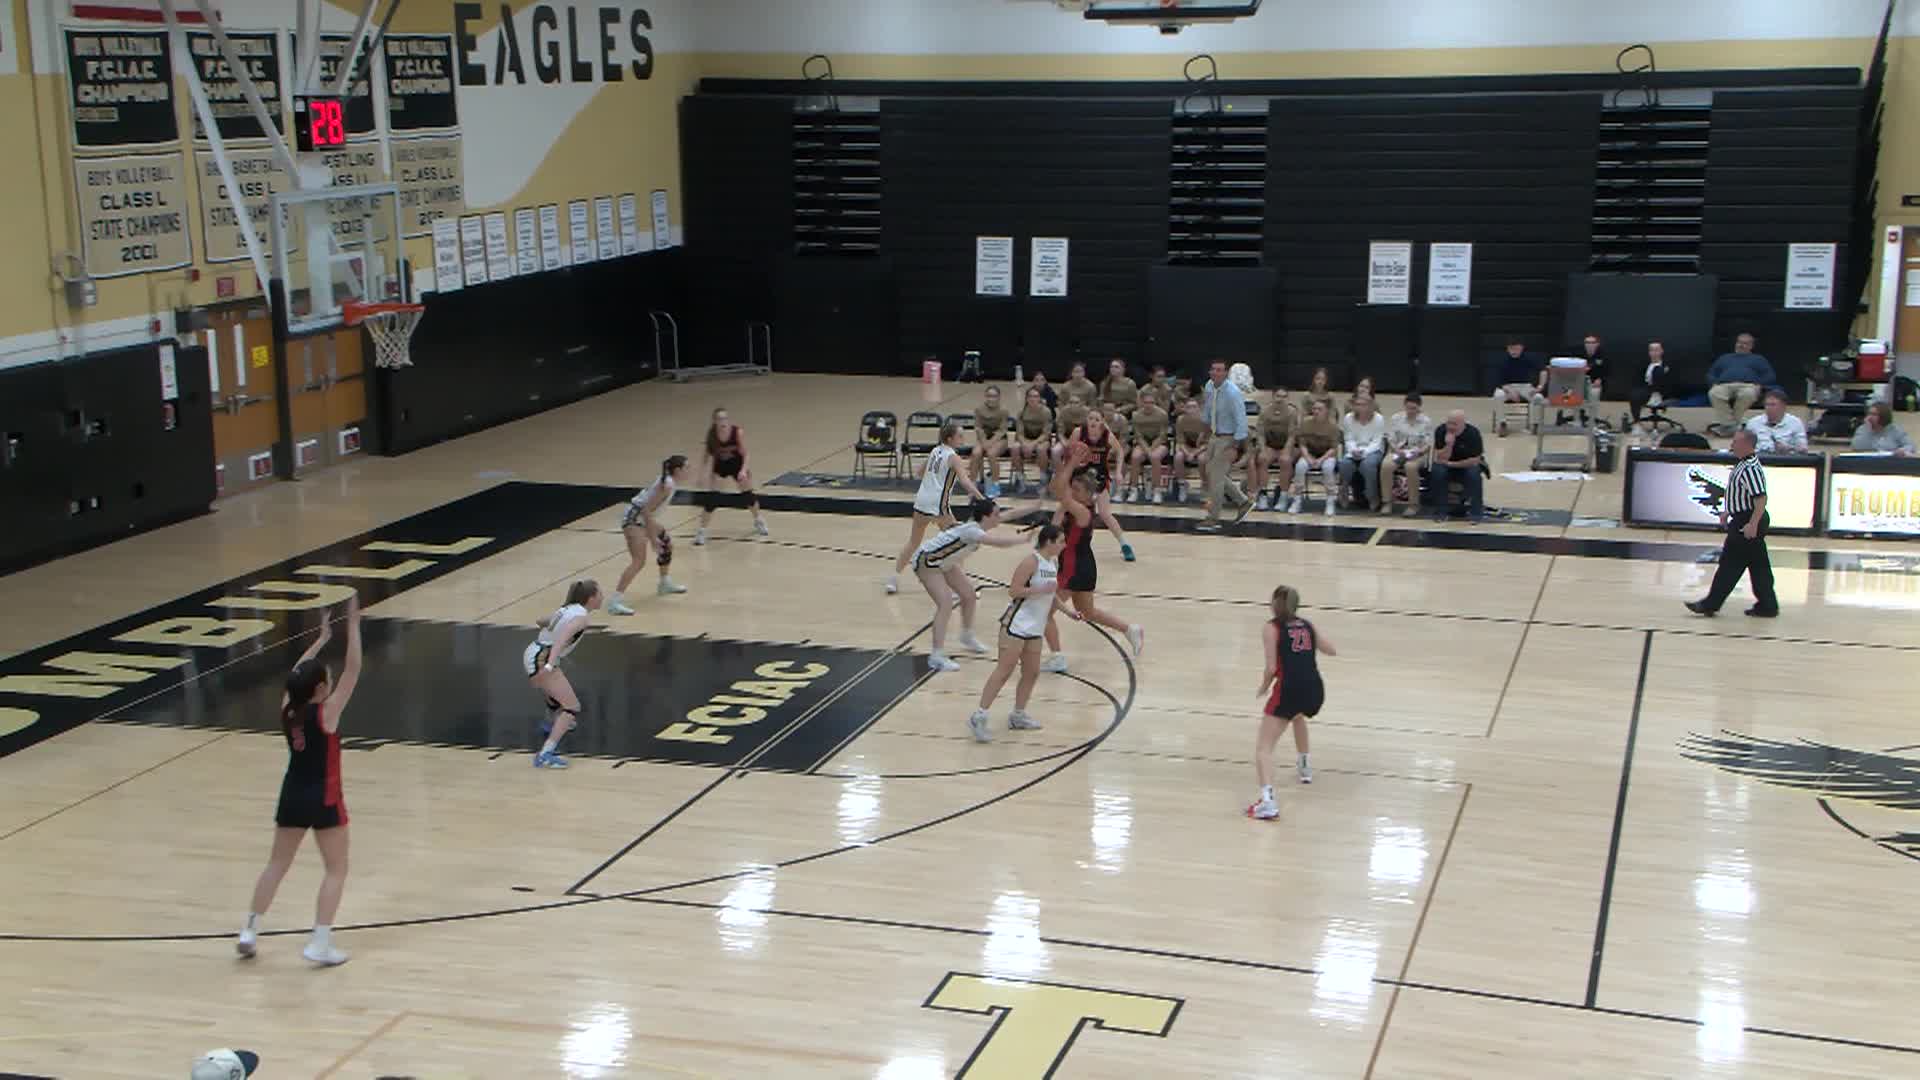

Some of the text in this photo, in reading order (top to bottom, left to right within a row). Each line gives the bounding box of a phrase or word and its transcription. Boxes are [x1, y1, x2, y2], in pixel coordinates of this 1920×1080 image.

[453, 3, 654, 86] EAGLES
[310, 100, 344, 145] 28
[402, 167, 437, 183] CLASS
[100, 191, 167, 210] CLASS L
[91, 212, 181, 240] STATE CHAMPIONS
[121, 243, 158, 262] 2001
[654, 660, 830, 744] FCIAC
[920, 971, 1186, 1080] T
